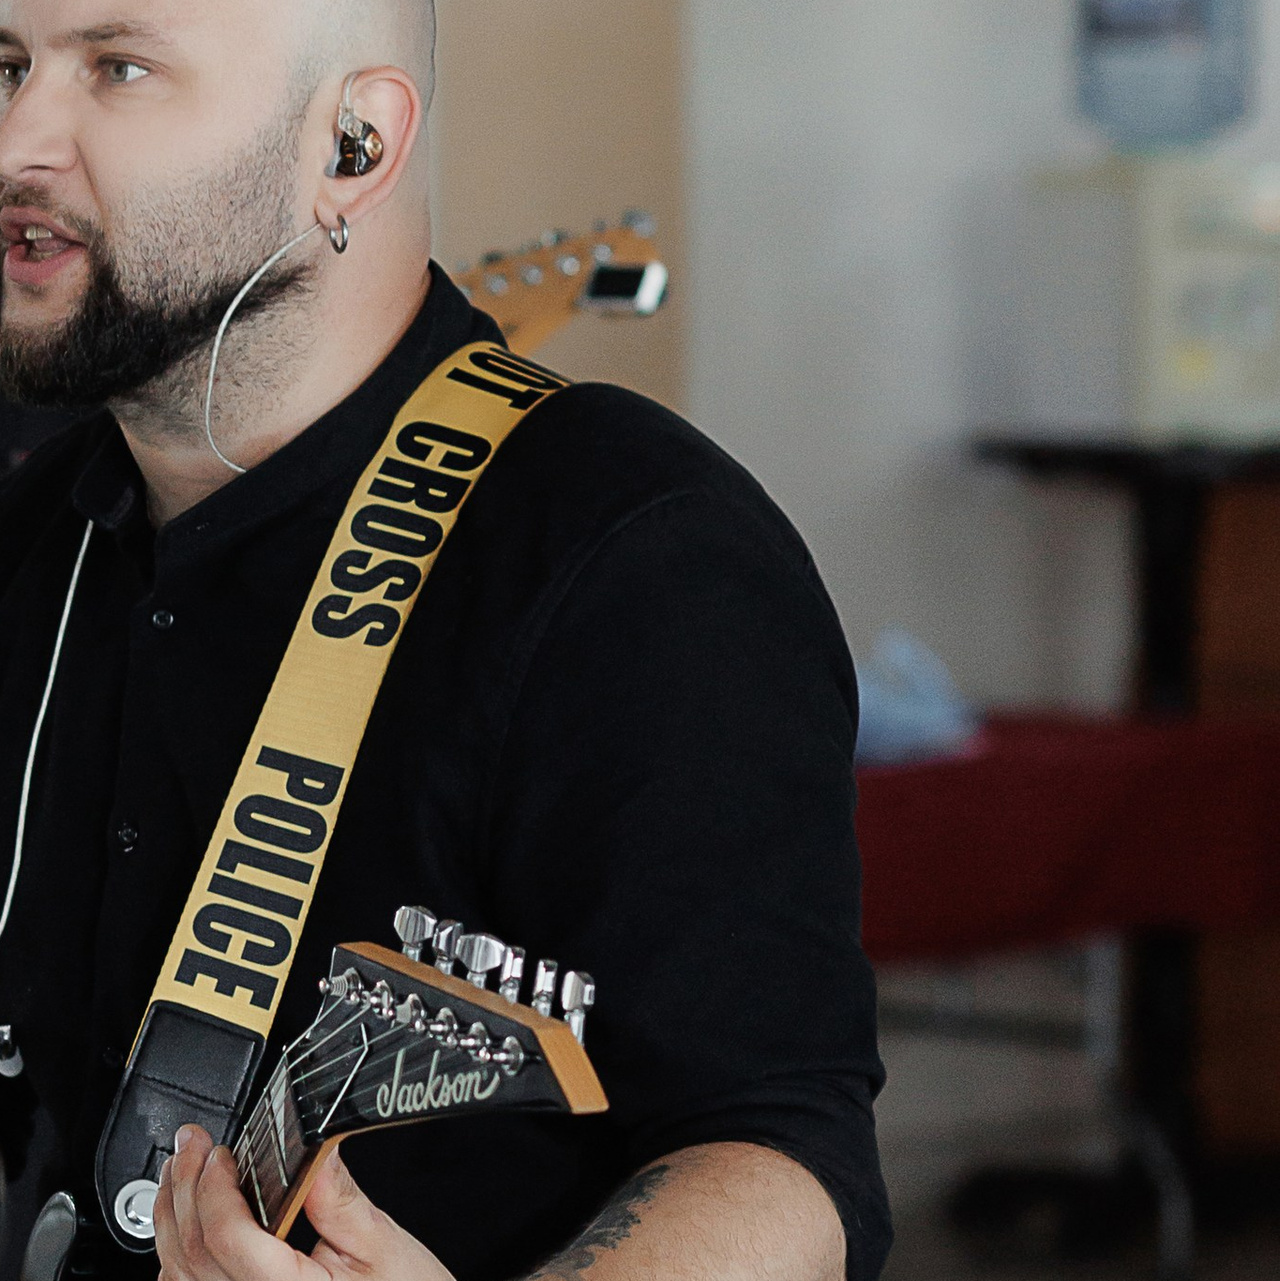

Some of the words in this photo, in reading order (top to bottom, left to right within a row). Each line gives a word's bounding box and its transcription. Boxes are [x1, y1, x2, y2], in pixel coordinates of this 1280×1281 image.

[446, 347, 573, 411] OT
[311, 419, 493, 648] CROSS
[174, 744, 347, 1013] POLICE
[376, 1049, 500, 1118] Jackson
